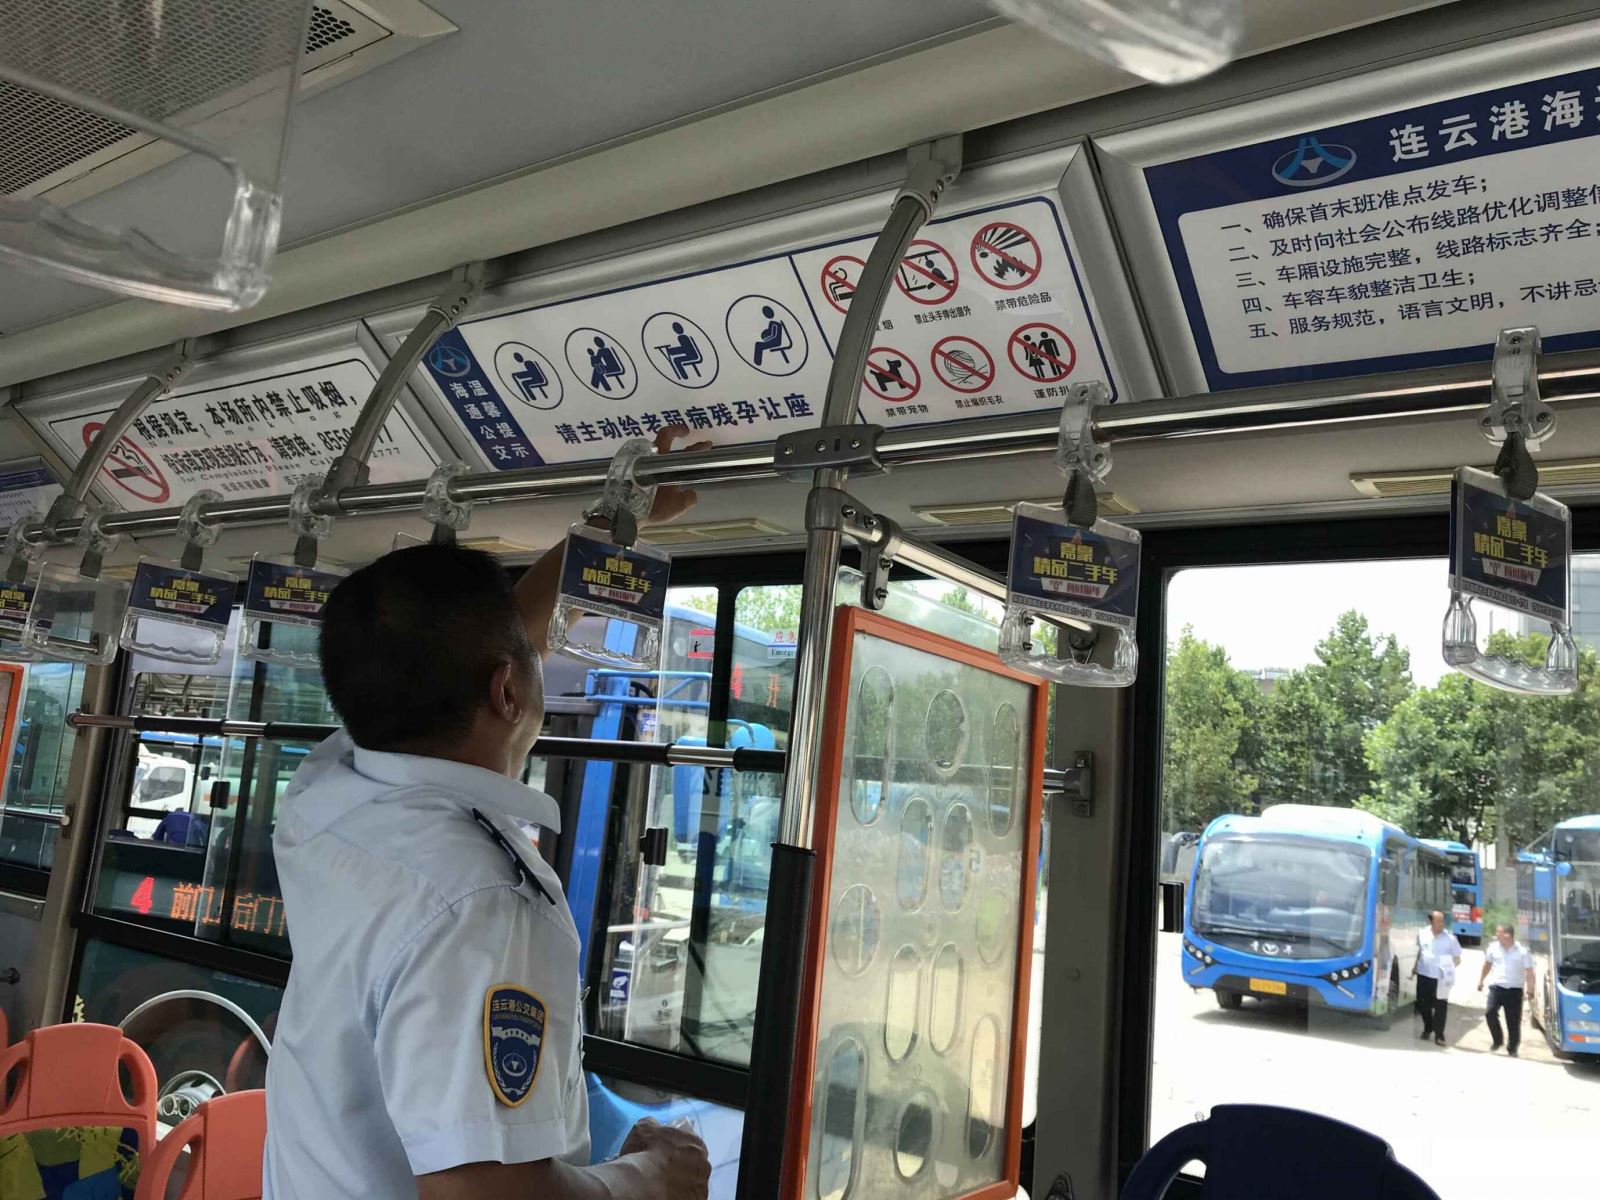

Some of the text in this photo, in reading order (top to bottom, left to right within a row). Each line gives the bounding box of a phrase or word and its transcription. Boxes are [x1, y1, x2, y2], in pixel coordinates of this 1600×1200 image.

[1389, 91, 1600, 162] 连云港海
[1221, 174, 1488, 233] 一、确保首末班准点发车；
[995, 292, 1052, 312] 禁带危险品
[1242, 269, 1475, 314] 四、车容车貌整洁卫生；
[1249, 279, 1600, 339] 五、服务规范，语言文明，不讲忌
[914, 305, 972, 325] 禁止头手伸出窗外
[1033, 385, 1070, 399] 谨防扒
[555, 393, 814, 446] 请主动给老弱病残孕让座
[886, 404, 929, 418] 禁带宠物
[1474, 532, 1548, 568] 精品二手车
[583, 567, 651, 592] 精品二手车
[1034, 556, 1118, 584] 精品二手车
[131, 877, 155, 914] 4
